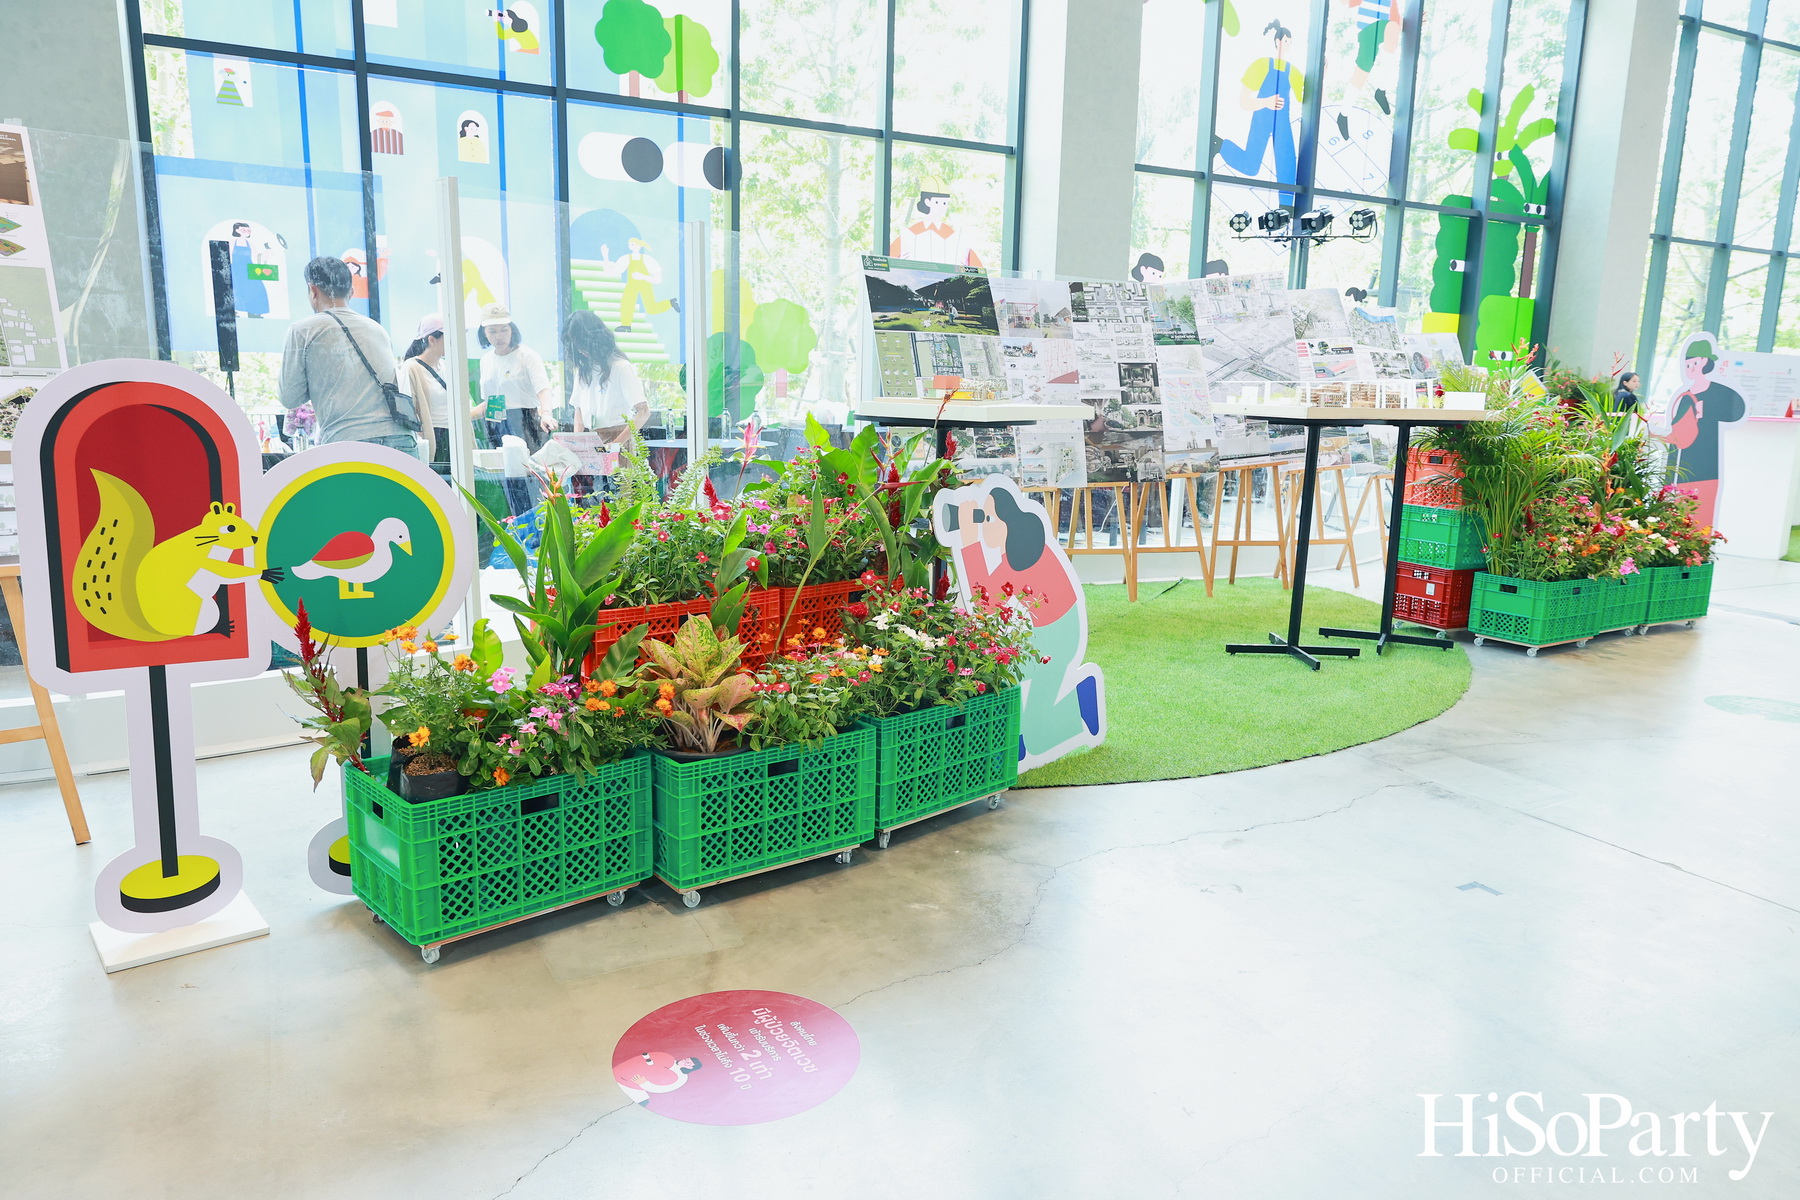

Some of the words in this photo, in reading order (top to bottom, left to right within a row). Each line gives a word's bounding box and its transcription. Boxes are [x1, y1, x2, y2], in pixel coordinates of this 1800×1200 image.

[716, 1023, 745, 1052] เพิ่มขึ้นกว่า
[748, 1027, 782, 1061] เข้ารับบริการ
[751, 1007, 819, 1073] มีผู้ป่วยจิตเวช
[789, 1020, 818, 1046] สังคมไทย
[694, 1024, 733, 1069] ในช่วงเวลาไม่ถึง
[729, 1067, 751, 1083] 10
[740, 1049, 763, 1061] 2
[749, 1061, 774, 1080] เท่า
